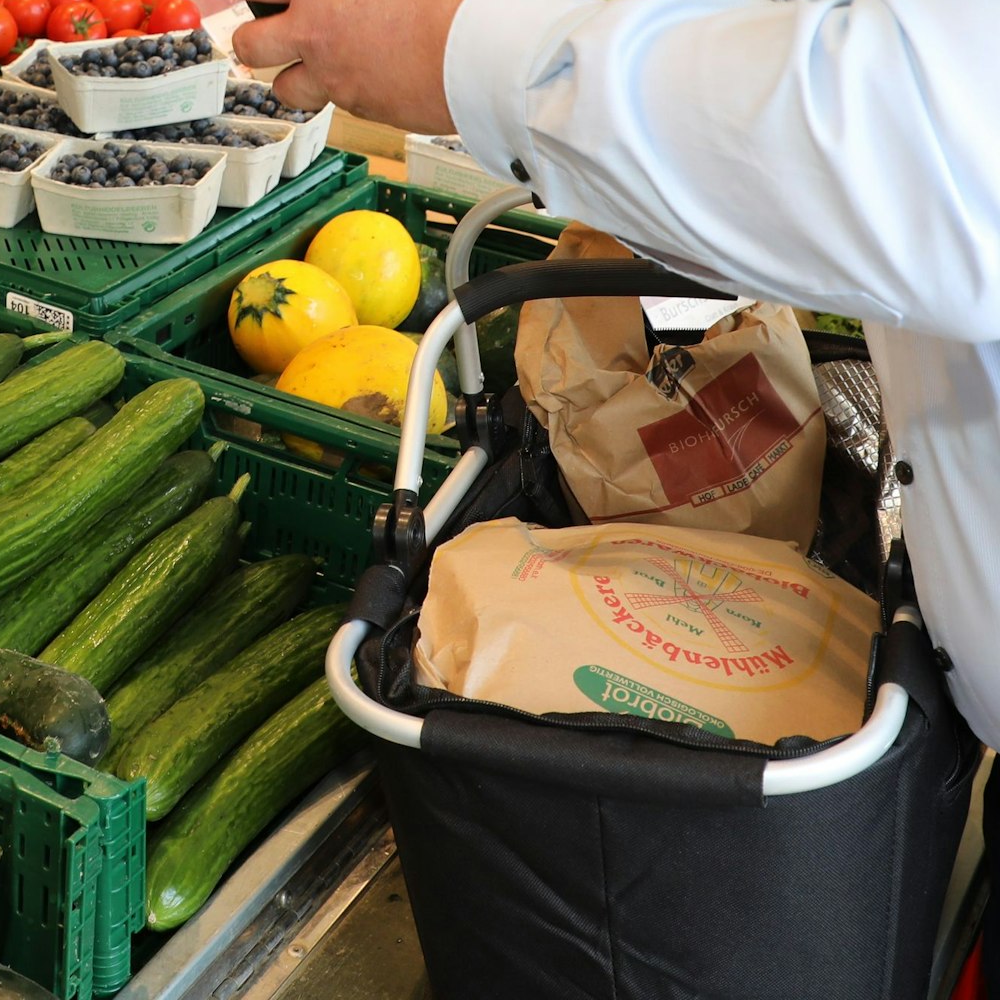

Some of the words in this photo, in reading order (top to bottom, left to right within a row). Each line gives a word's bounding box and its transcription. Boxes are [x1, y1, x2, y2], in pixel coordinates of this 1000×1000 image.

[10, 300, 30, 316] 104
[715, 391, 760, 431] URSCH
[727, 477, 750, 493] LADE
[633, 570, 666, 589] Brot
[666, 614, 705, 637] Mehl
[726, 608, 762, 629] Korn
[589, 665, 652, 698] VOLLWERTIG
